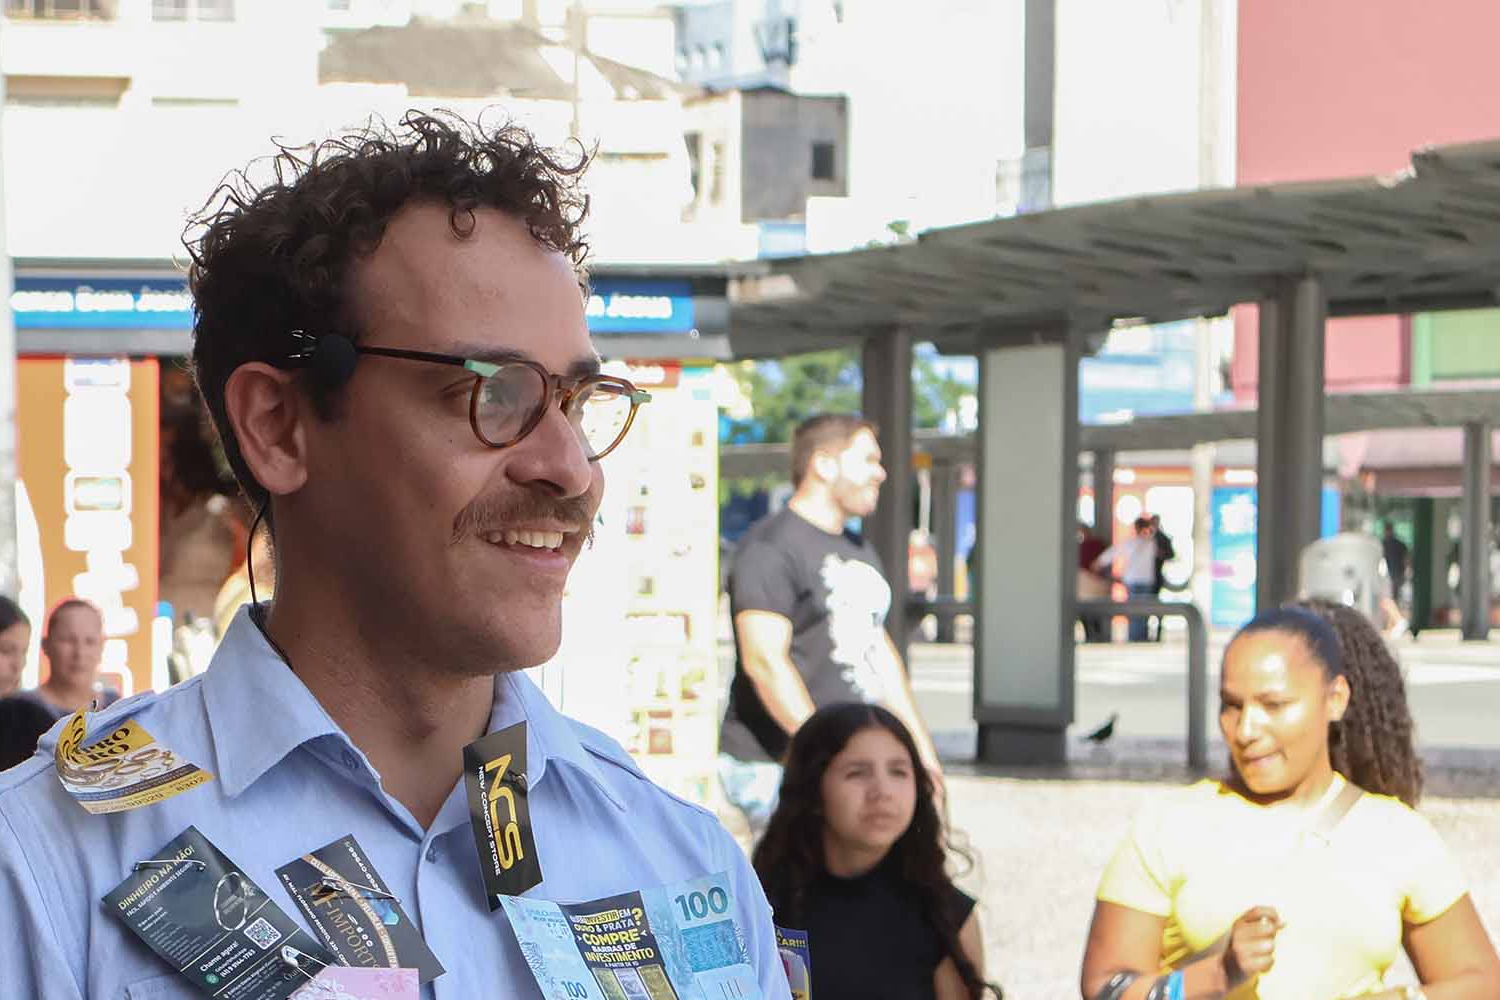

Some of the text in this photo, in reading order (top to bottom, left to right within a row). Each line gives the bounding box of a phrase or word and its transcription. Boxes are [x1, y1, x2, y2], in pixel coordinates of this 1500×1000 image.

[478, 766, 501, 876] NEW CONCEPT STORE
[116, 874, 160, 910] DINHEIRO
[157, 862, 173, 877] NA
[670, 885, 733, 921] 100
[601, 918, 636, 931] PRATA
[580, 927, 642, 946] COMPRE
[199, 952, 222, 973] Chame
[219, 939, 240, 958] agora!
[583, 945, 656, 965] INVESTIMENTO
[591, 943, 623, 954] BARRAS
[562, 981, 589, 1000] 100
